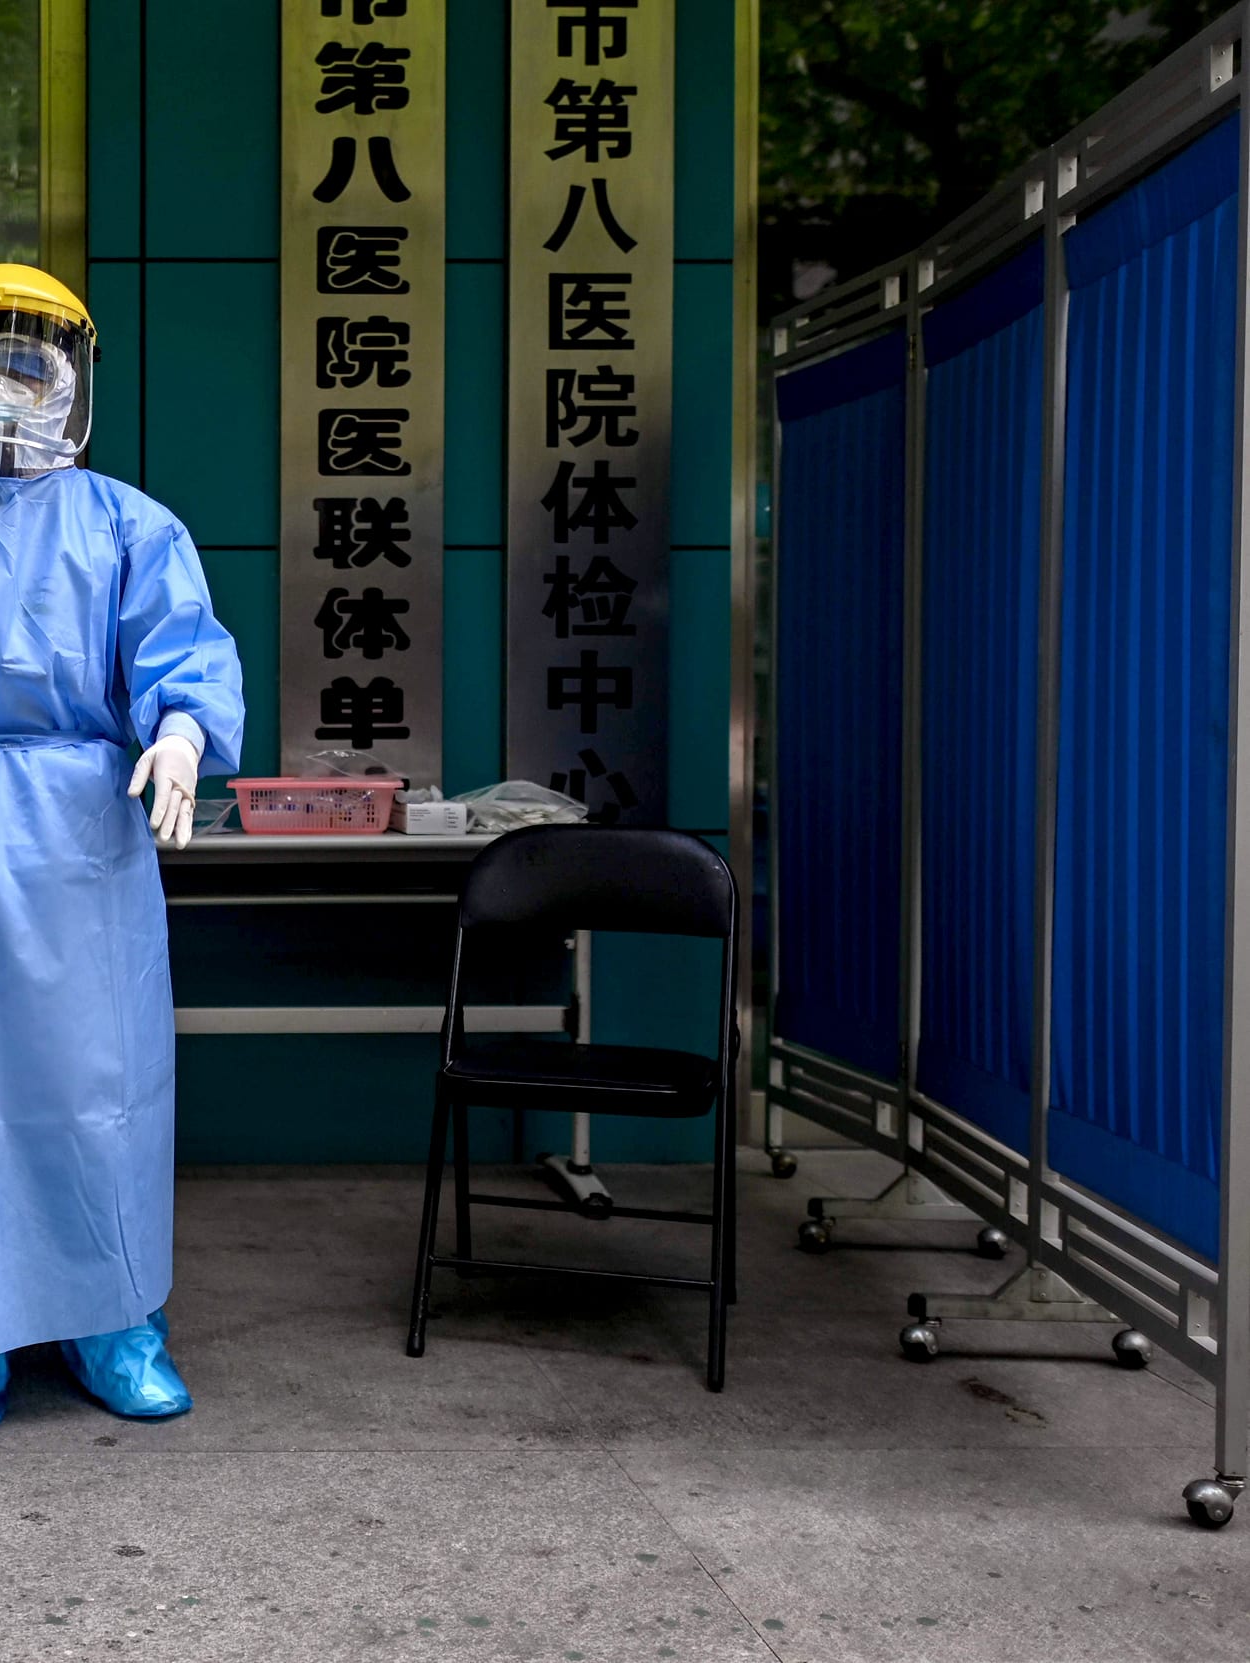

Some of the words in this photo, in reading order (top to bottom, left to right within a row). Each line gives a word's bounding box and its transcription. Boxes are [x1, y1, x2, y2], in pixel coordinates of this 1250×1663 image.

[312, 0, 412, 790] 第八医院医联体单
[541, 0, 640, 824] 市第八医院体检中心
